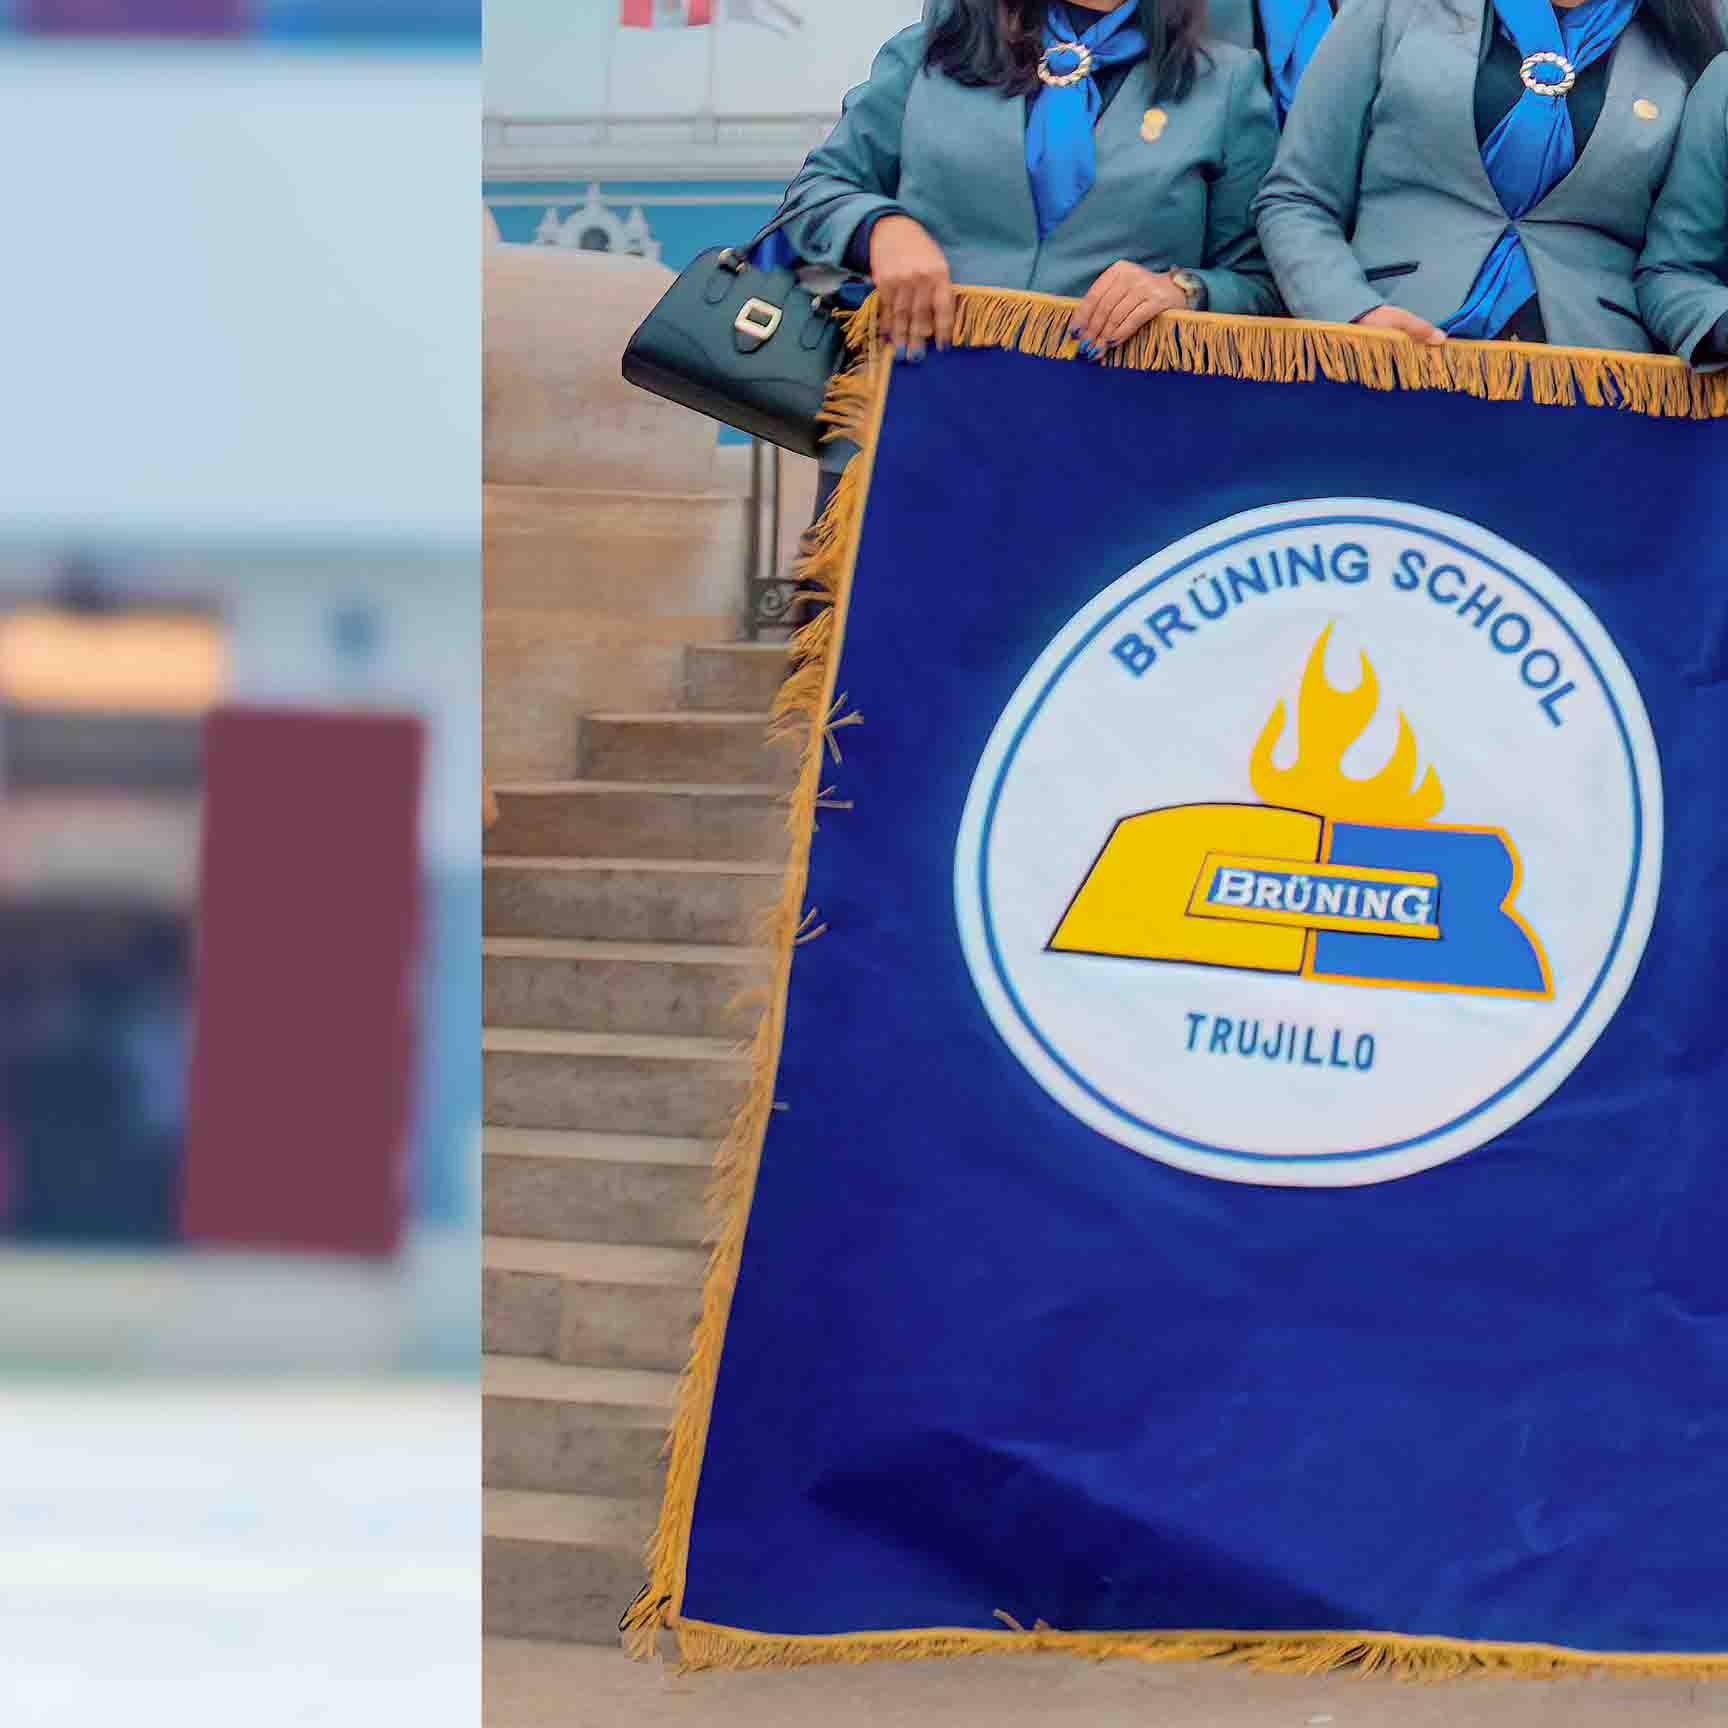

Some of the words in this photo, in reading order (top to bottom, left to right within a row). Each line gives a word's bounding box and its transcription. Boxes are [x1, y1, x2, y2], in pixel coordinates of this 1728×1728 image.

[1109, 543, 1370, 679] BRÜNING
[1392, 549, 1578, 728] SCHOOL
[1212, 868, 1432, 925] BRÜNING
[1185, 1012, 1376, 1072] TRUJILLO
